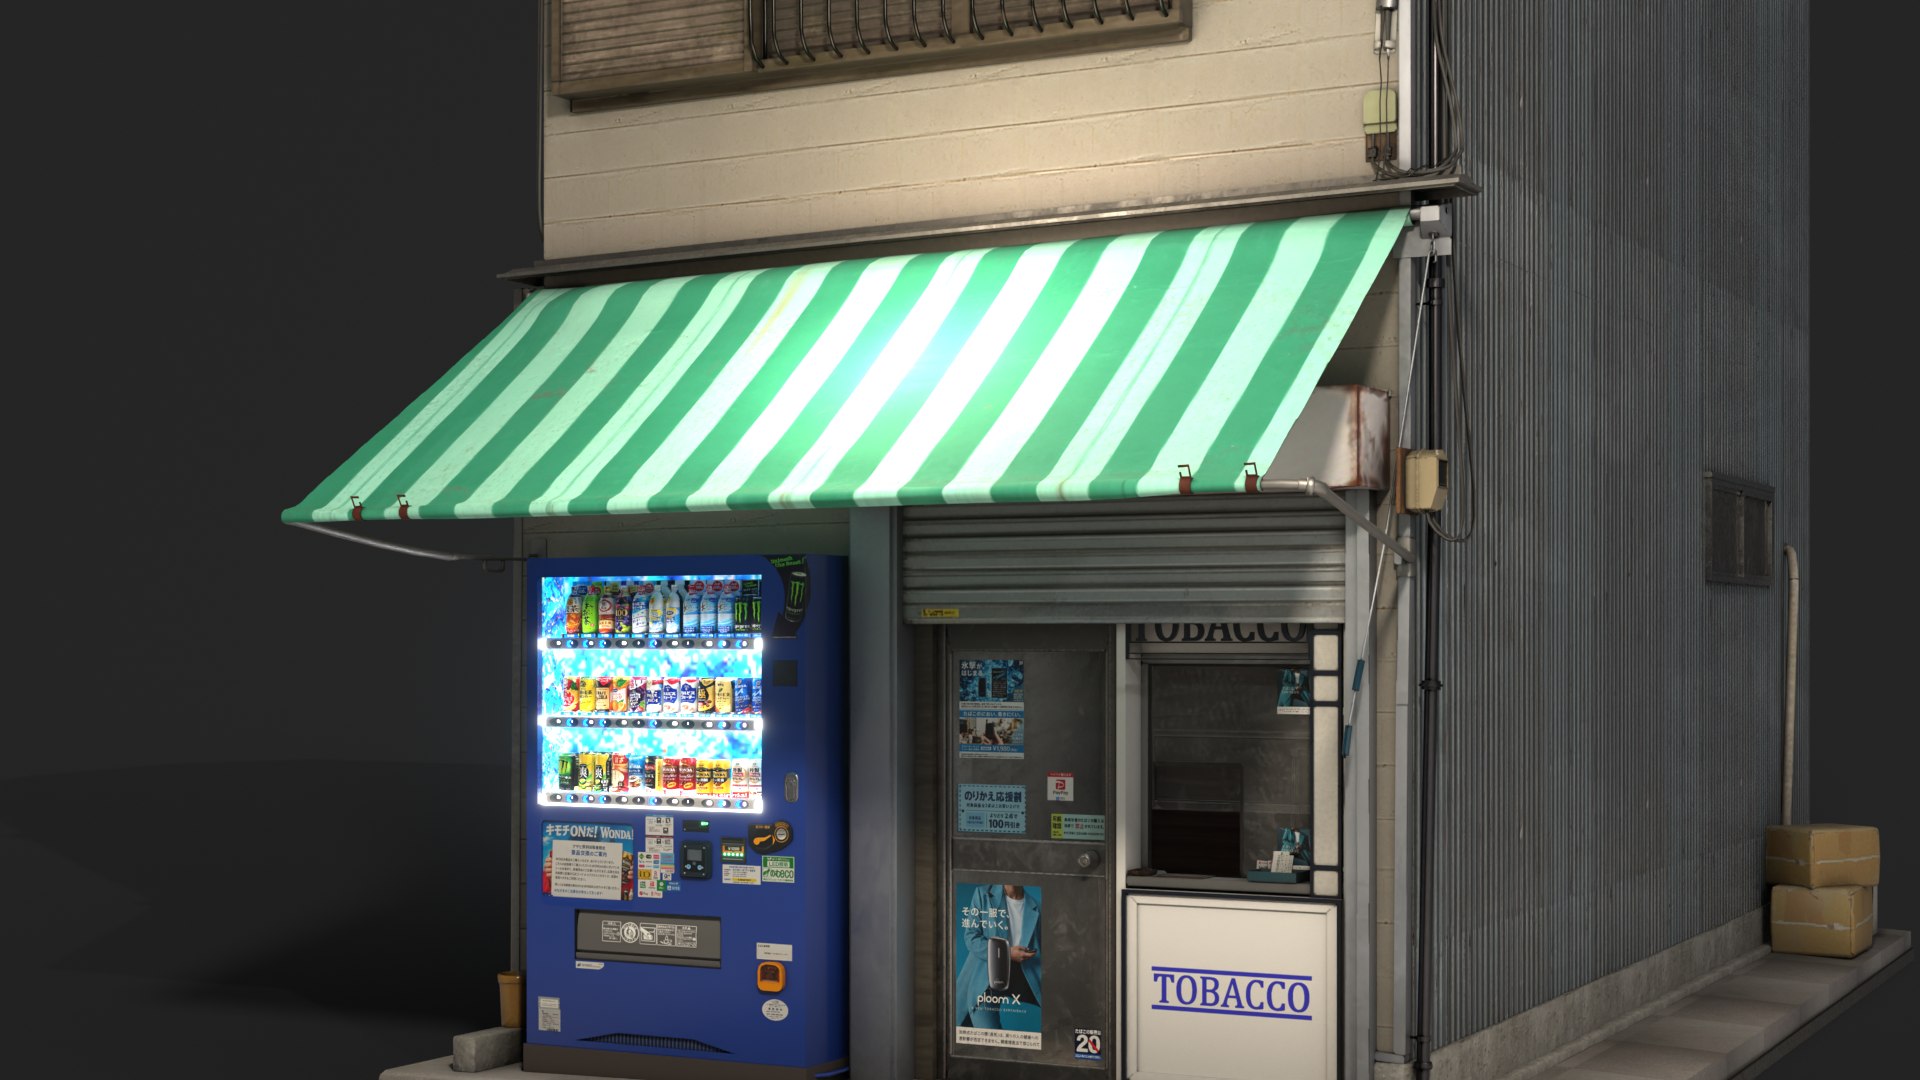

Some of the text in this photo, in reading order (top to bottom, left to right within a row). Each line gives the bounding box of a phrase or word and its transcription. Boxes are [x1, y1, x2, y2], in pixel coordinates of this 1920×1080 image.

[964, 791, 1022, 803] のりかえ応援割
[962, 906, 1010, 919] その一服で、
[962, 918, 1009, 931] 進んでいく。
[977, 992, 1021, 1007] ploom X
[1154, 973, 1310, 1013] TOBACCO
[1076, 1034, 1101, 1054] 20
